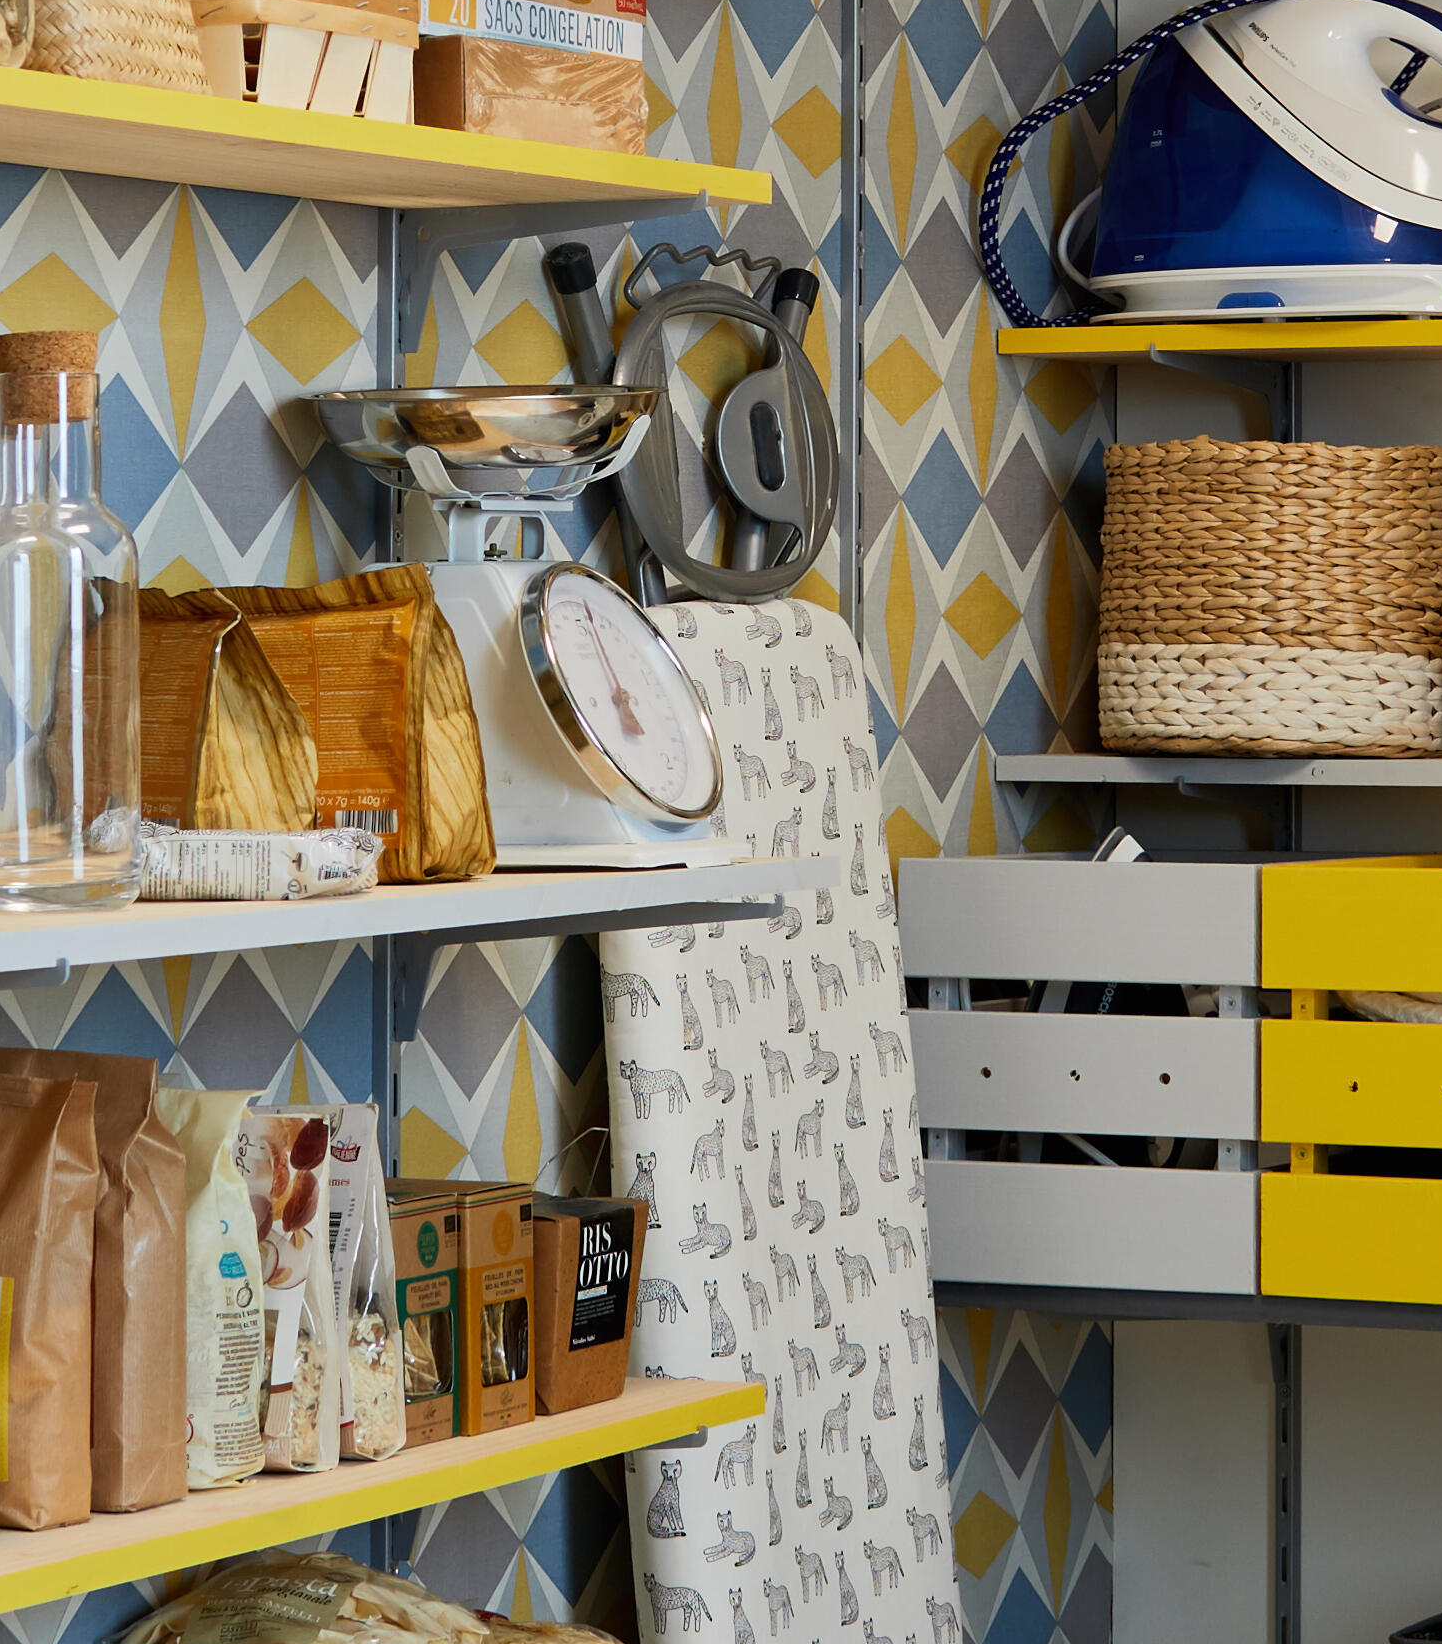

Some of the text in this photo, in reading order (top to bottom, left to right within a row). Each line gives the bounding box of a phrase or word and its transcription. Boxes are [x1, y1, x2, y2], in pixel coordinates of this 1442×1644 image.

[528, 4, 625, 56] CONGELATION
[582, 1222, 612, 1257] RIS
[579, 1249, 629, 1288] OTTO
